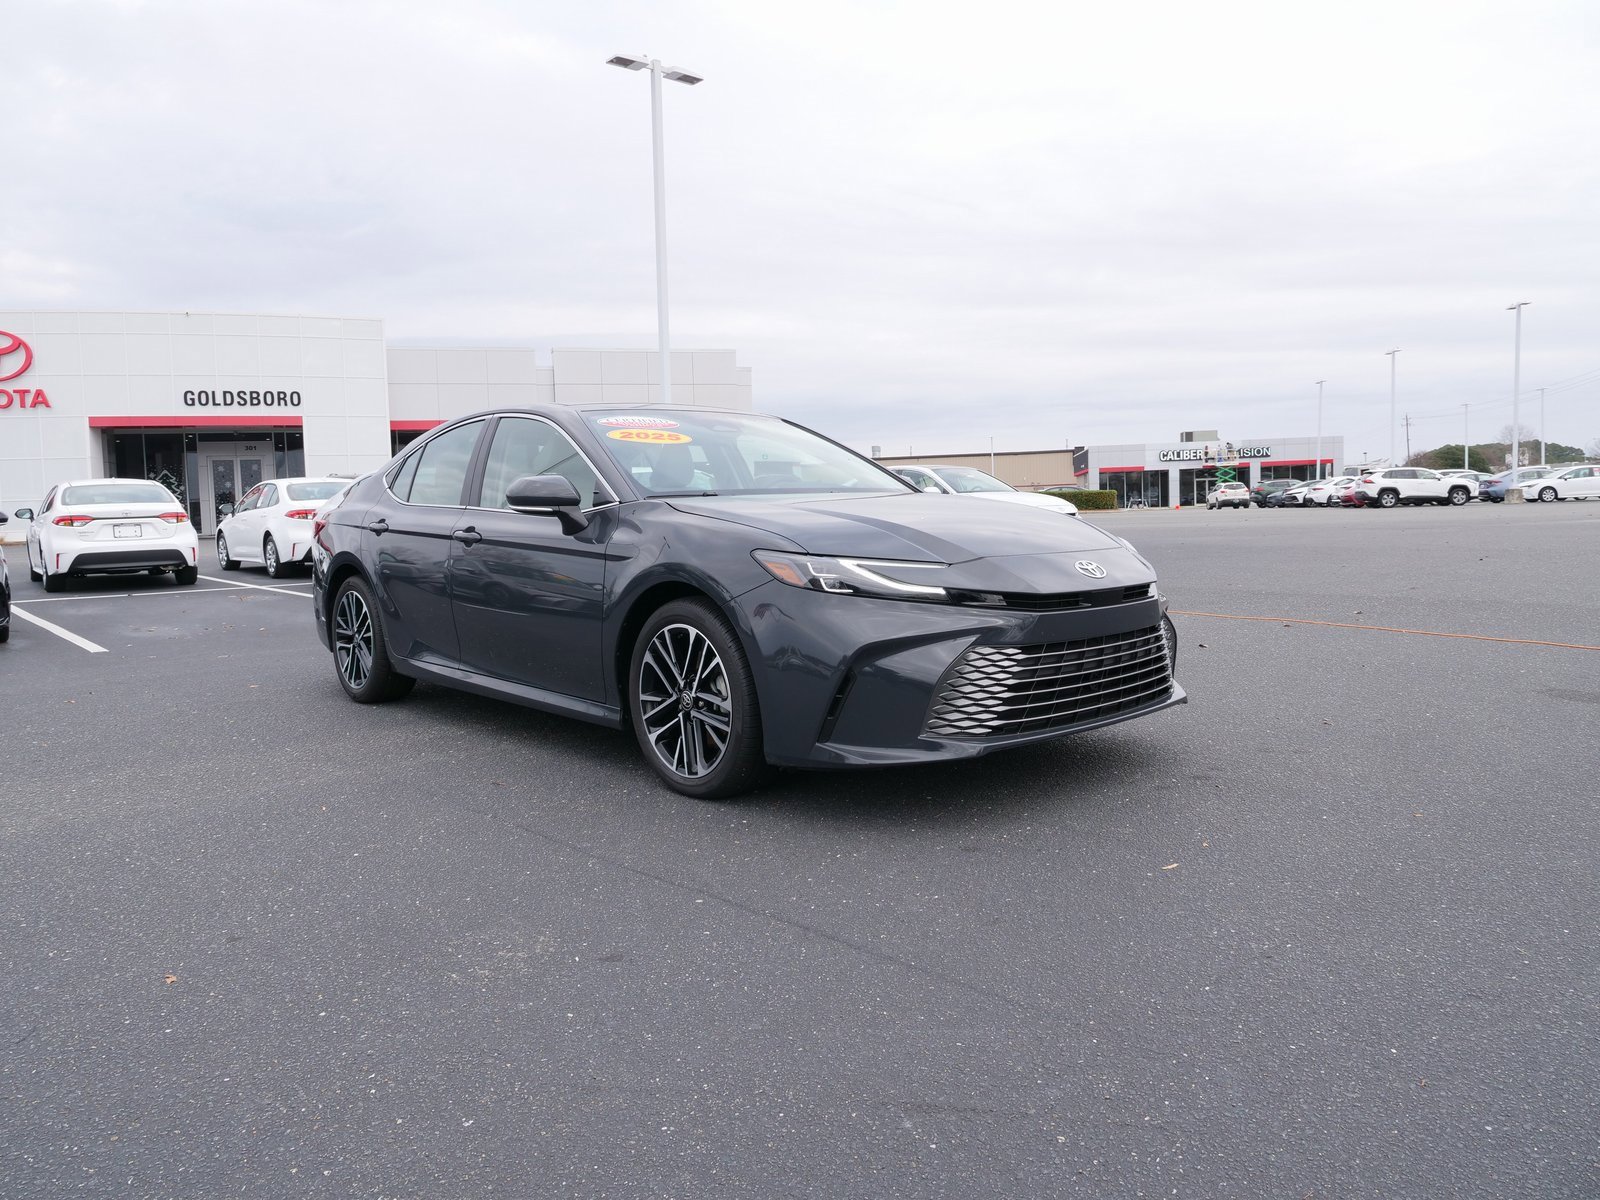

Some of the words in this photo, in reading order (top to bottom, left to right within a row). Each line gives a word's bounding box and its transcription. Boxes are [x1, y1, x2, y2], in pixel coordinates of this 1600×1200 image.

[183, 390, 302, 407] GOLDSBORO
[619, 431, 681, 441] 2025
[1160, 449, 1203, 461] CALIBER
[1236, 447, 1271, 458] ISION
